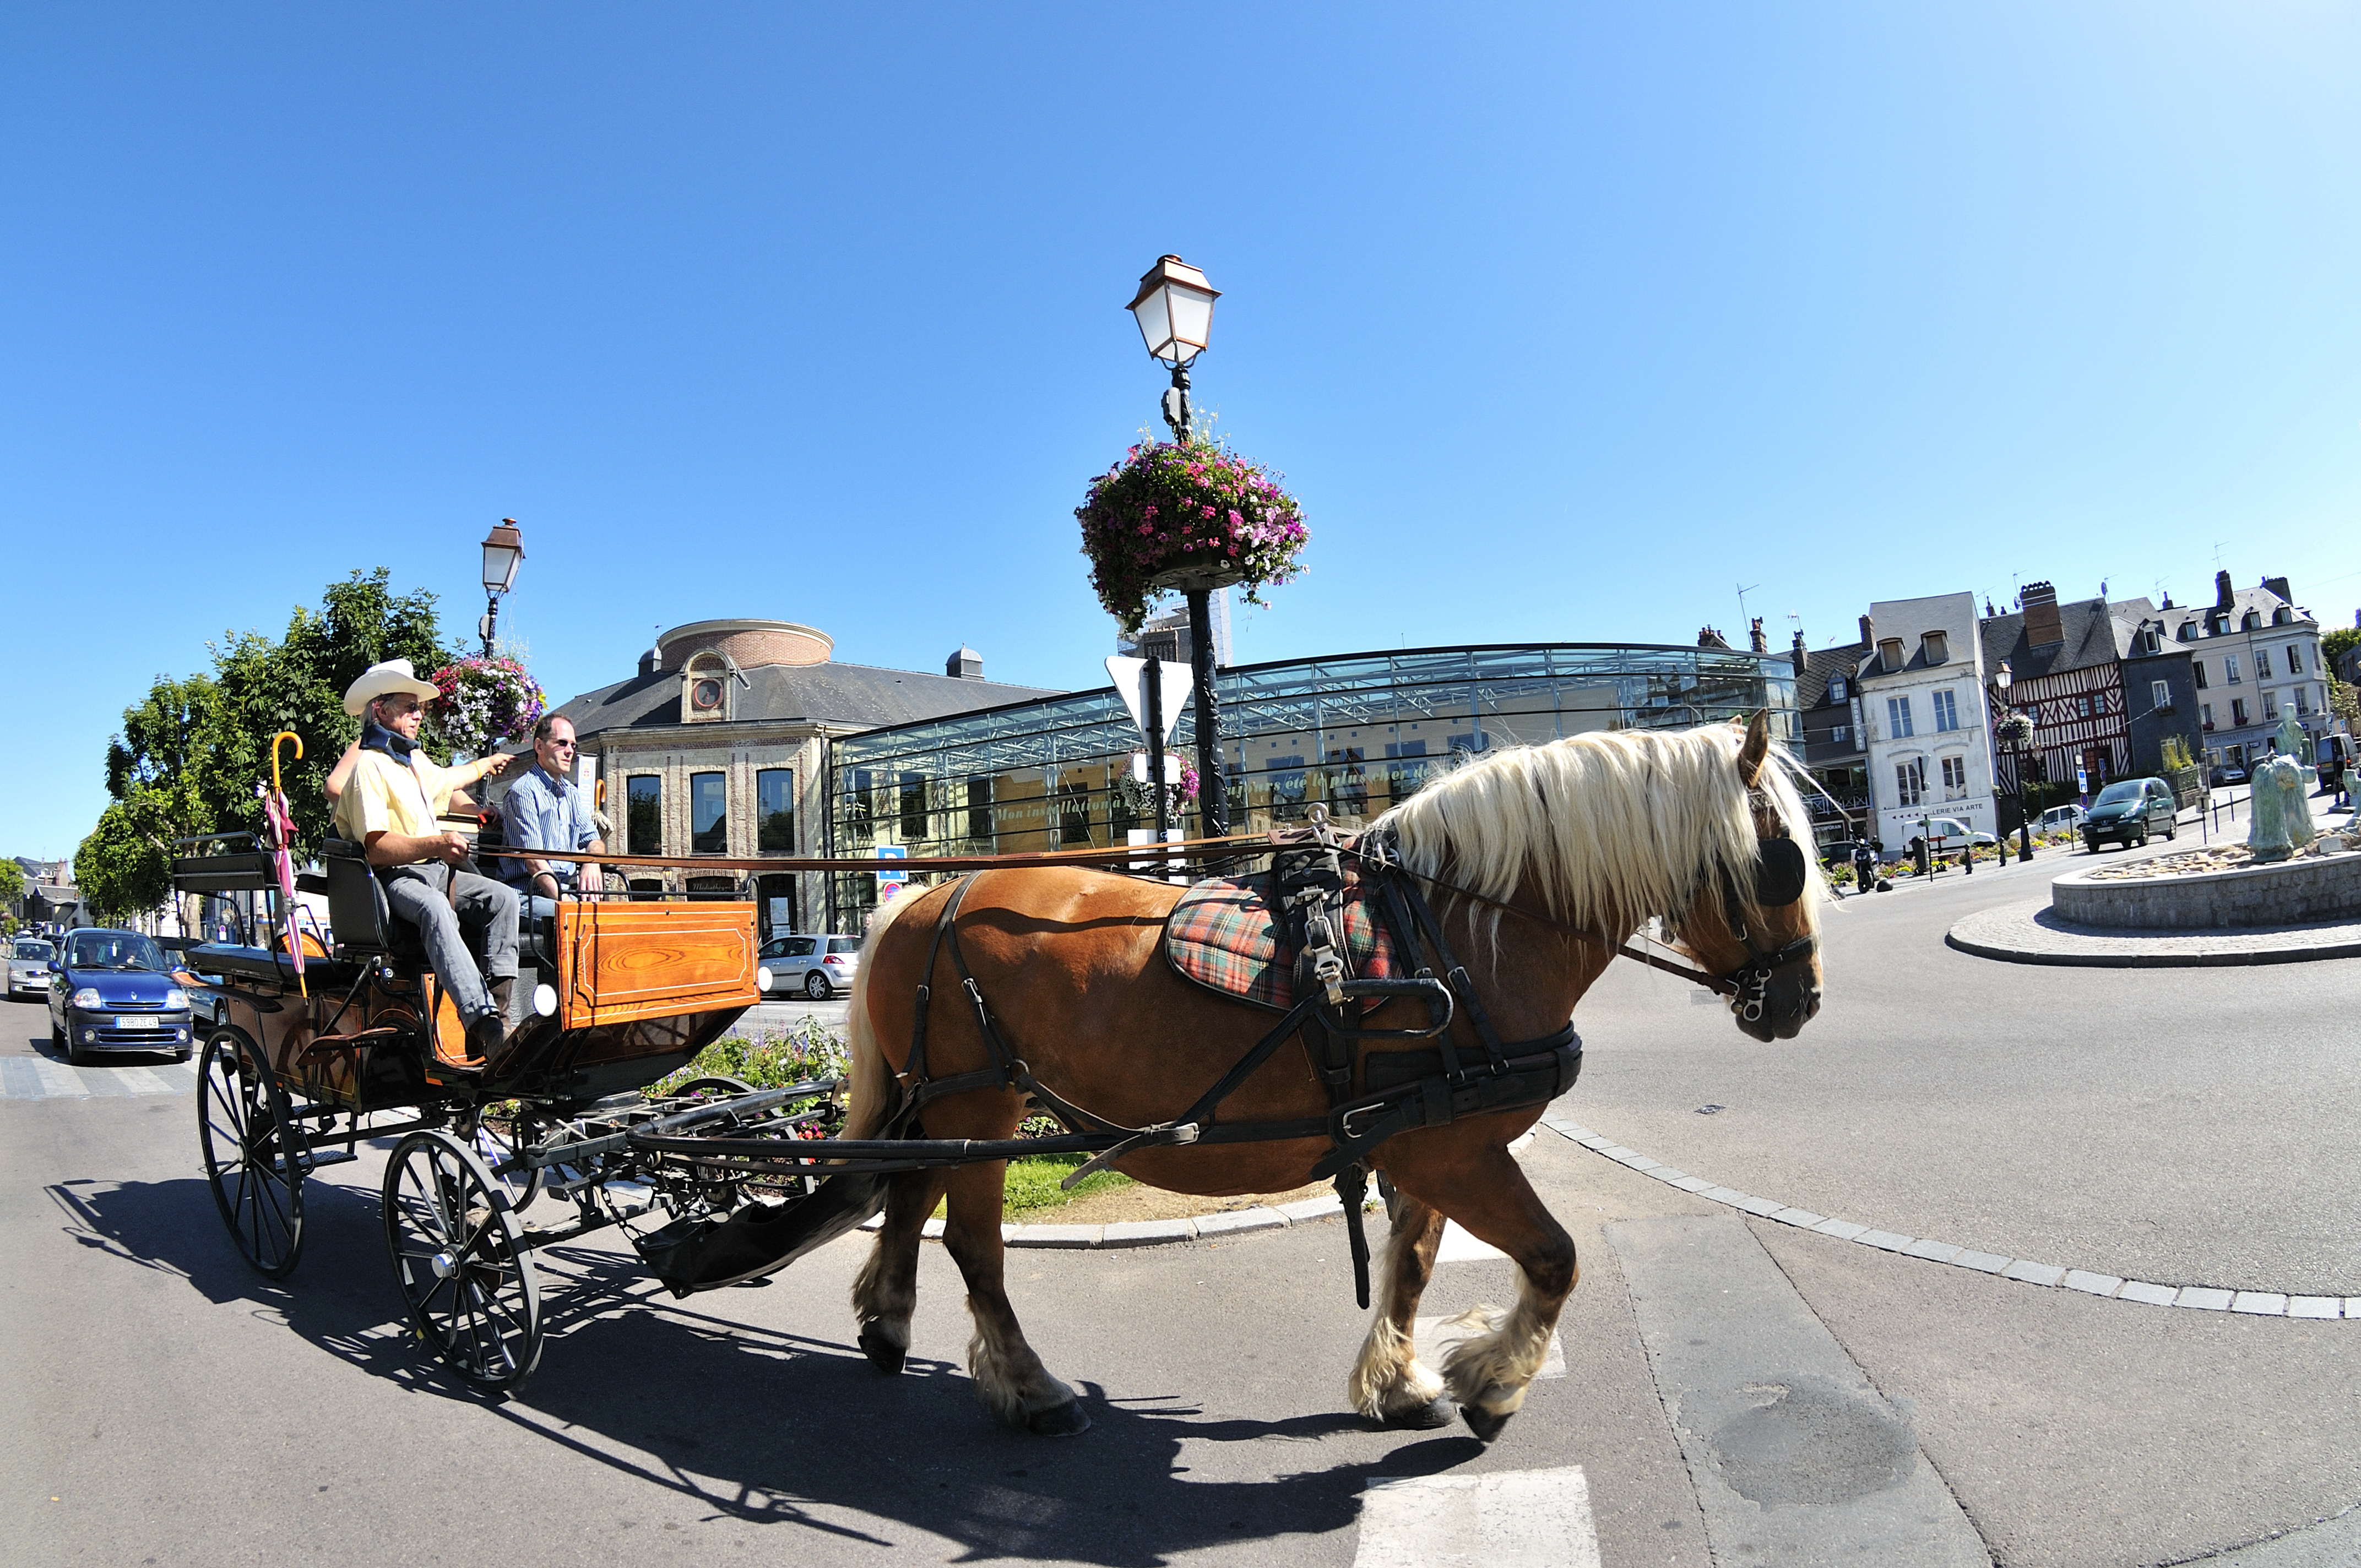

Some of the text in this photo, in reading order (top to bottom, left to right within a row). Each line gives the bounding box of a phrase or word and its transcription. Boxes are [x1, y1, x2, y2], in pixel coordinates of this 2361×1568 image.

[1852, 699, 1860, 730] MODERN
[2209, 732, 2254, 744] LAVOMATIQUE
[581, 783, 591, 814] OFFIC
[996, 808, 1023, 821] Mon
[1227, 781, 1280, 798] ujours
[1285, 775, 1307, 790] été
[1312, 774, 1326, 787] le
[1329, 771, 1367, 789] plus
[1372, 768, 1408, 782] cher
[122, 1018, 156, 1027] 5980 ZE 49
